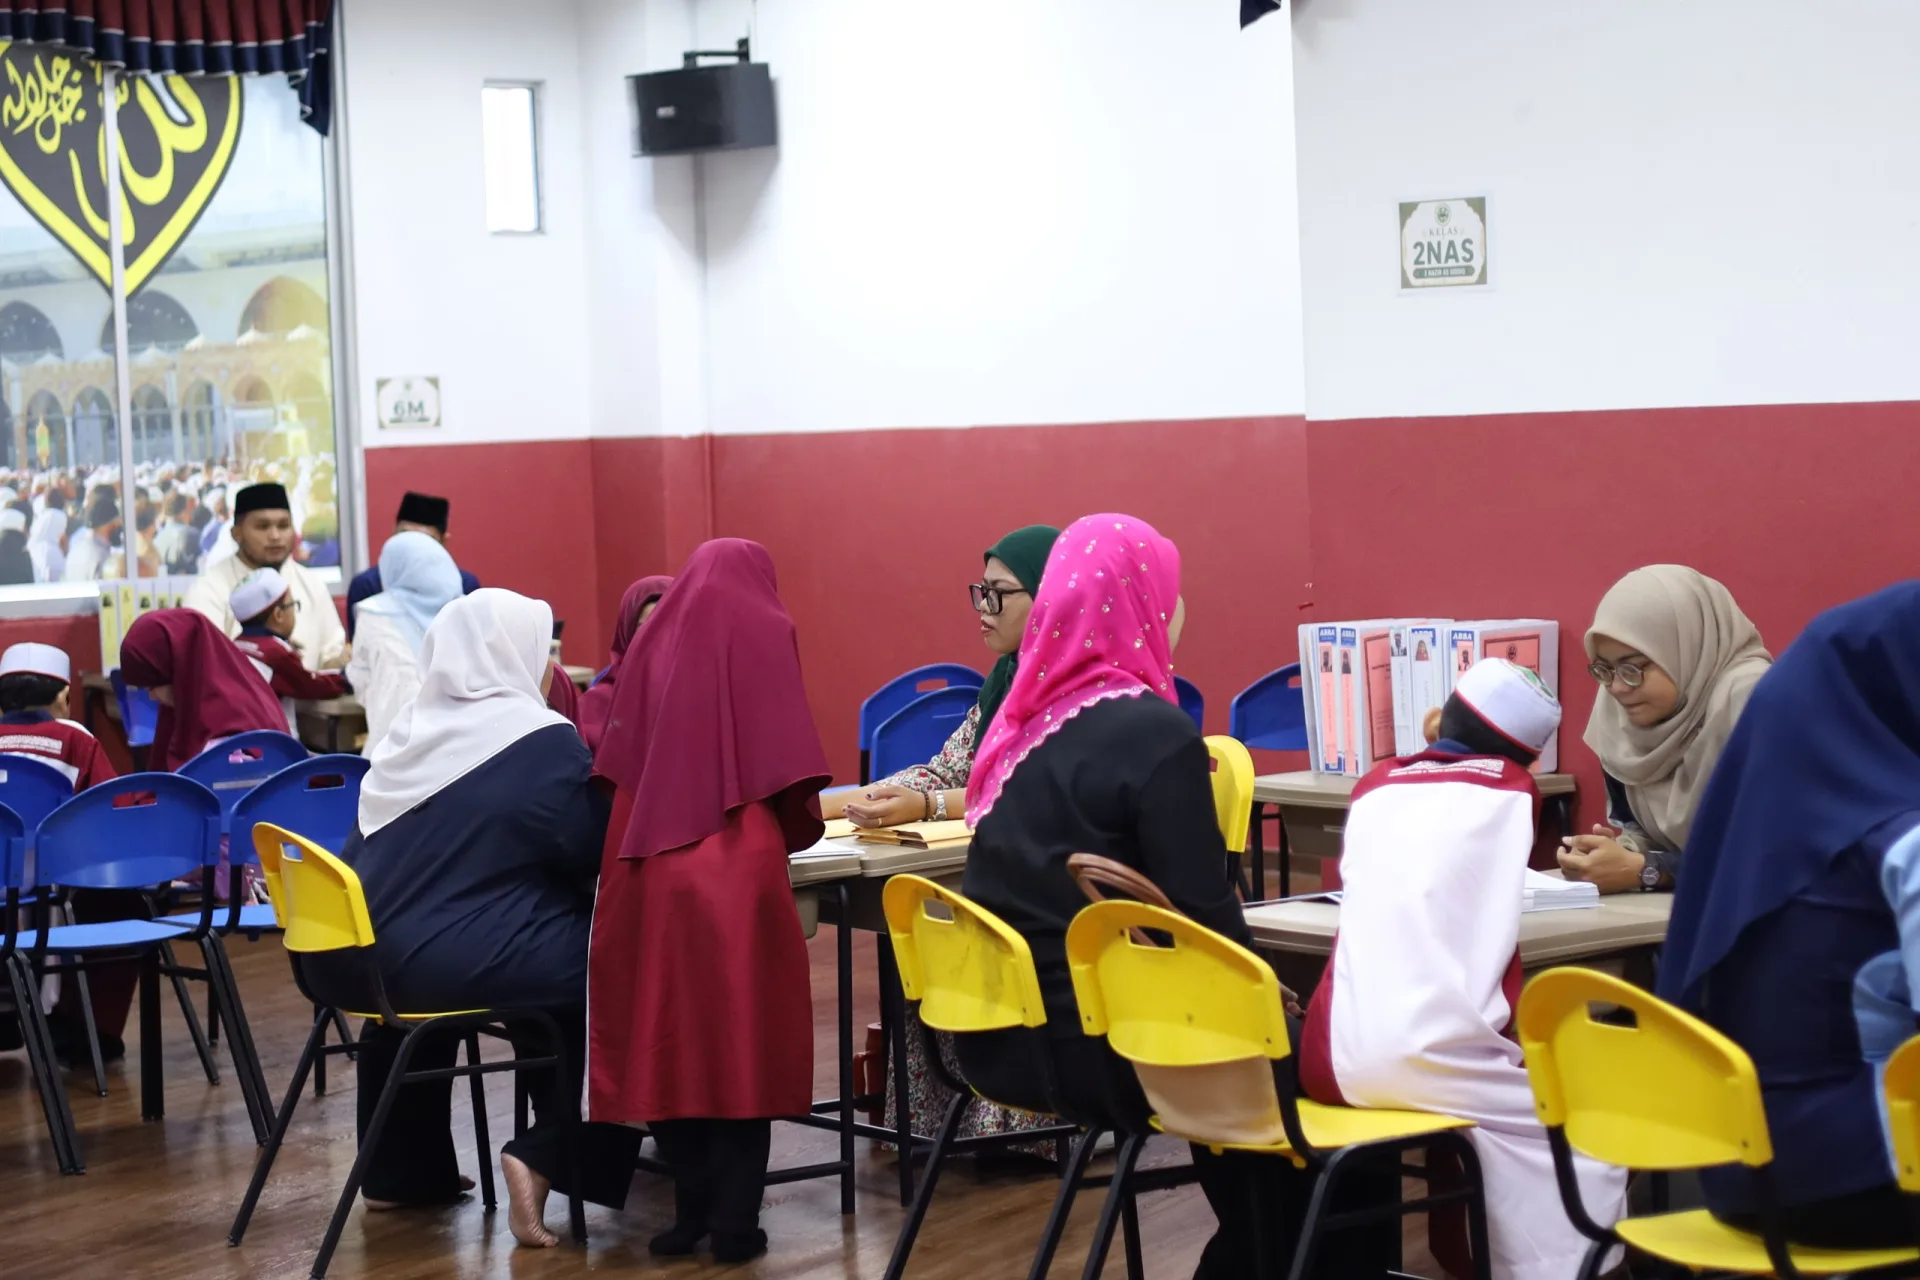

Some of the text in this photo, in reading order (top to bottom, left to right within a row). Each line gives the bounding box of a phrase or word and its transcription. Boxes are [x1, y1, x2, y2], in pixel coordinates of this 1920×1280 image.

[1412, 238, 1474, 265] 2NAS
[393, 400, 424, 416] 6M
[1319, 628, 1335, 637] ABBA
[1342, 630, 1355, 638] ABBA
[1452, 632, 1472, 641] ABBA
